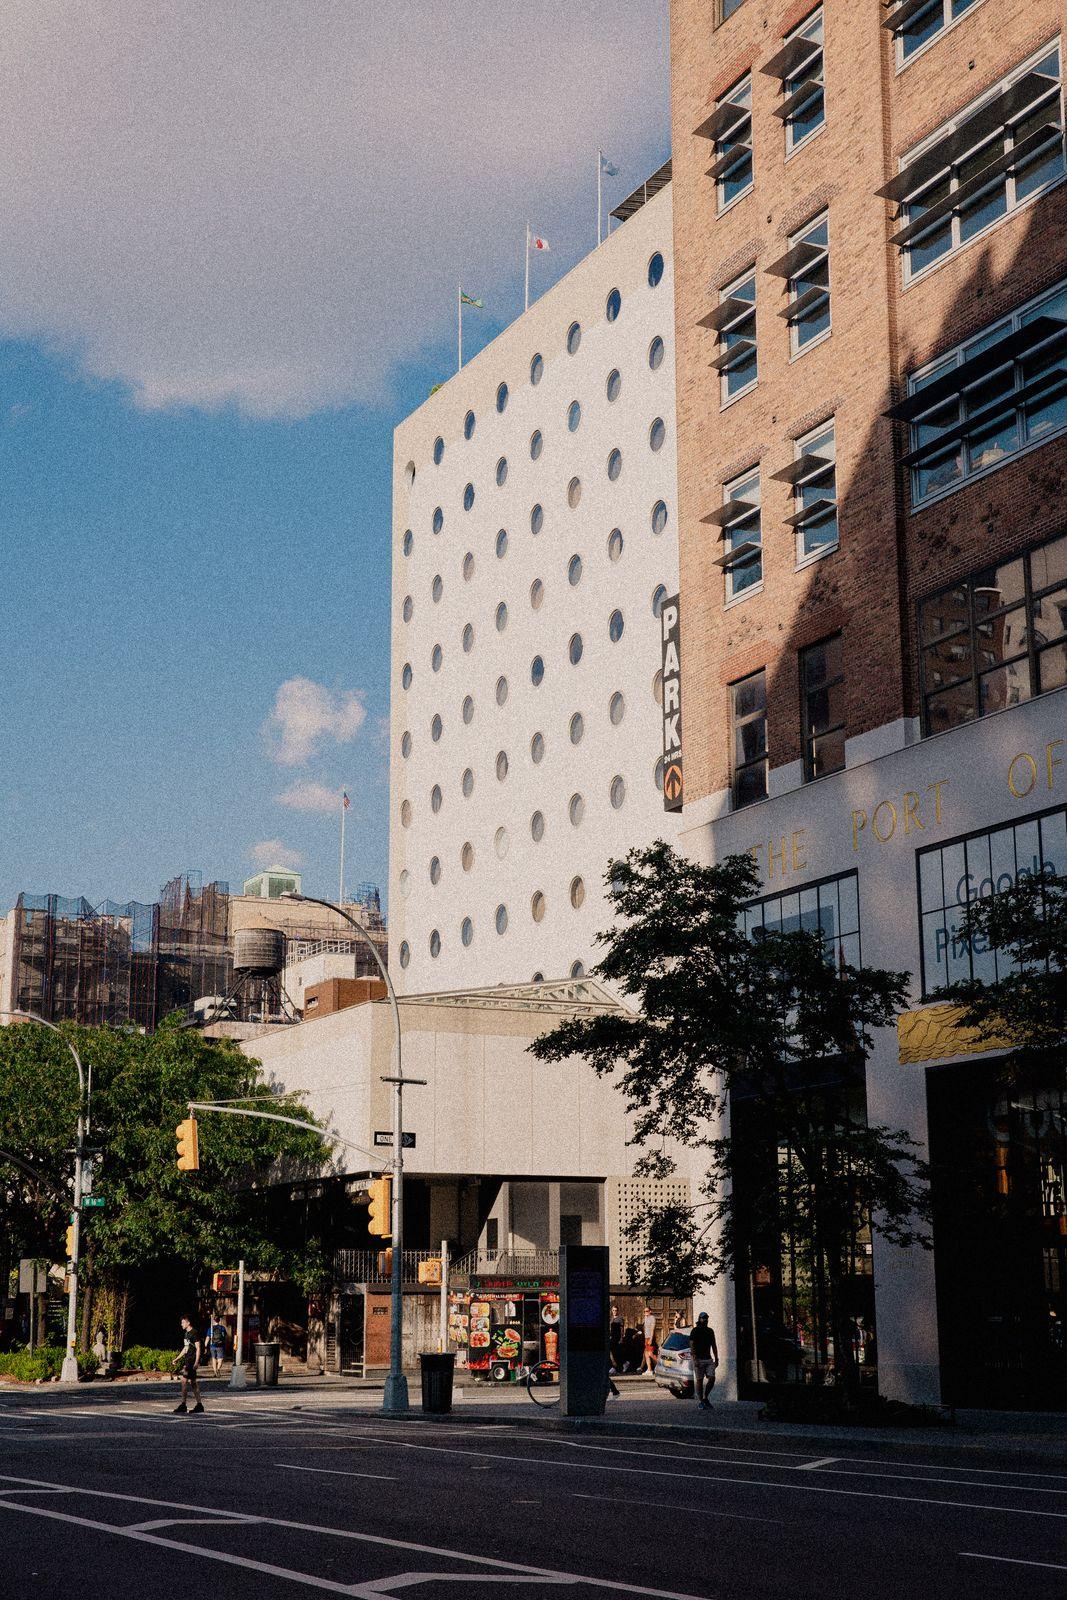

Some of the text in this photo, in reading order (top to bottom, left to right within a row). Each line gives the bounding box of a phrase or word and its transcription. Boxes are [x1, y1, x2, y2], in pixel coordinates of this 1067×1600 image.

[664, 605, 681, 750] PARK
[746, 739, 1065, 880] THE PORT OF
